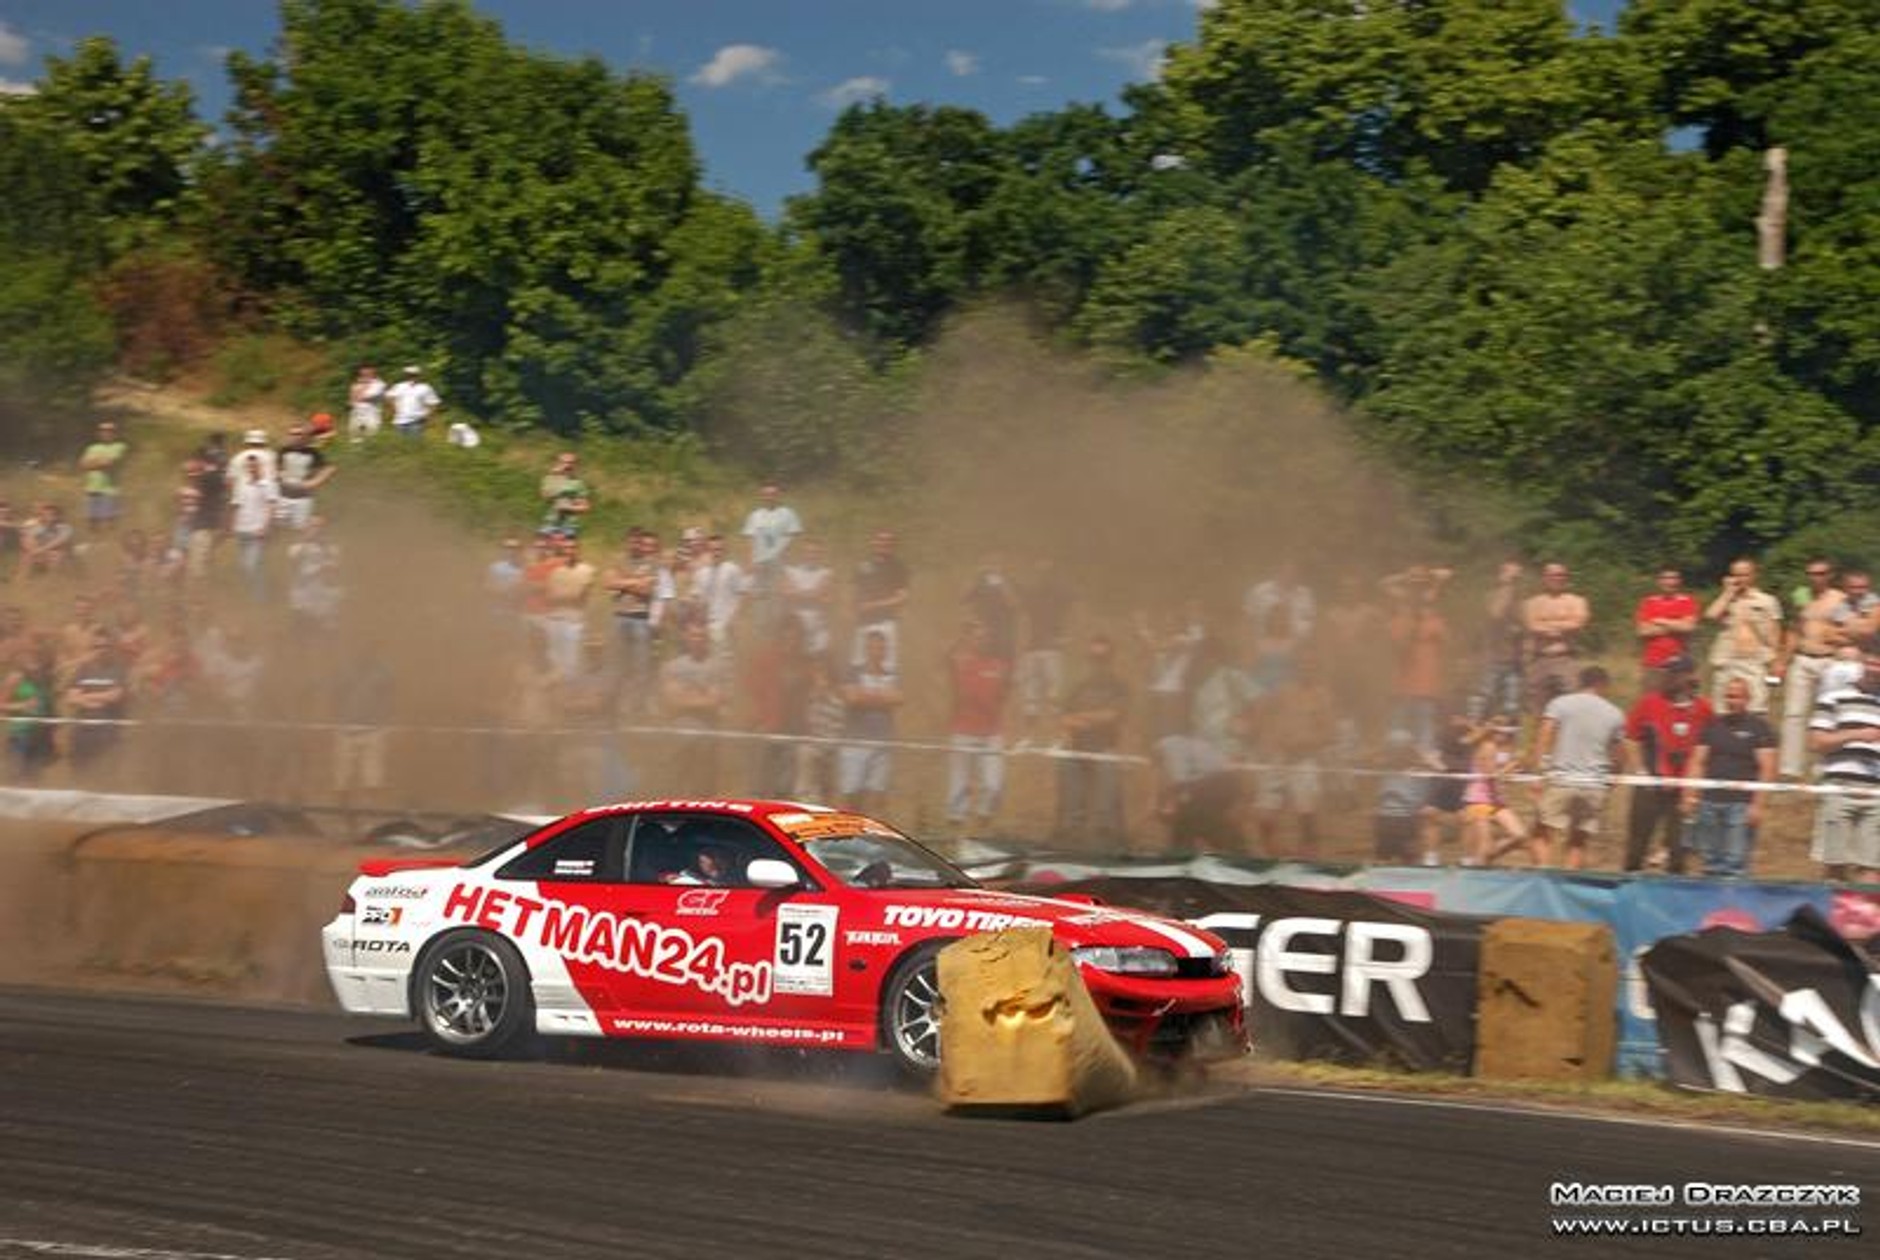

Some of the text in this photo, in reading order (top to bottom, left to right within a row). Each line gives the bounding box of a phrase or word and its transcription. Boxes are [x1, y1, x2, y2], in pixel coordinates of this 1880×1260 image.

[884, 905, 965, 927] TOYO
[442, 882, 773, 1005] HETMAN24.pl
[780, 922, 826, 966] 52
